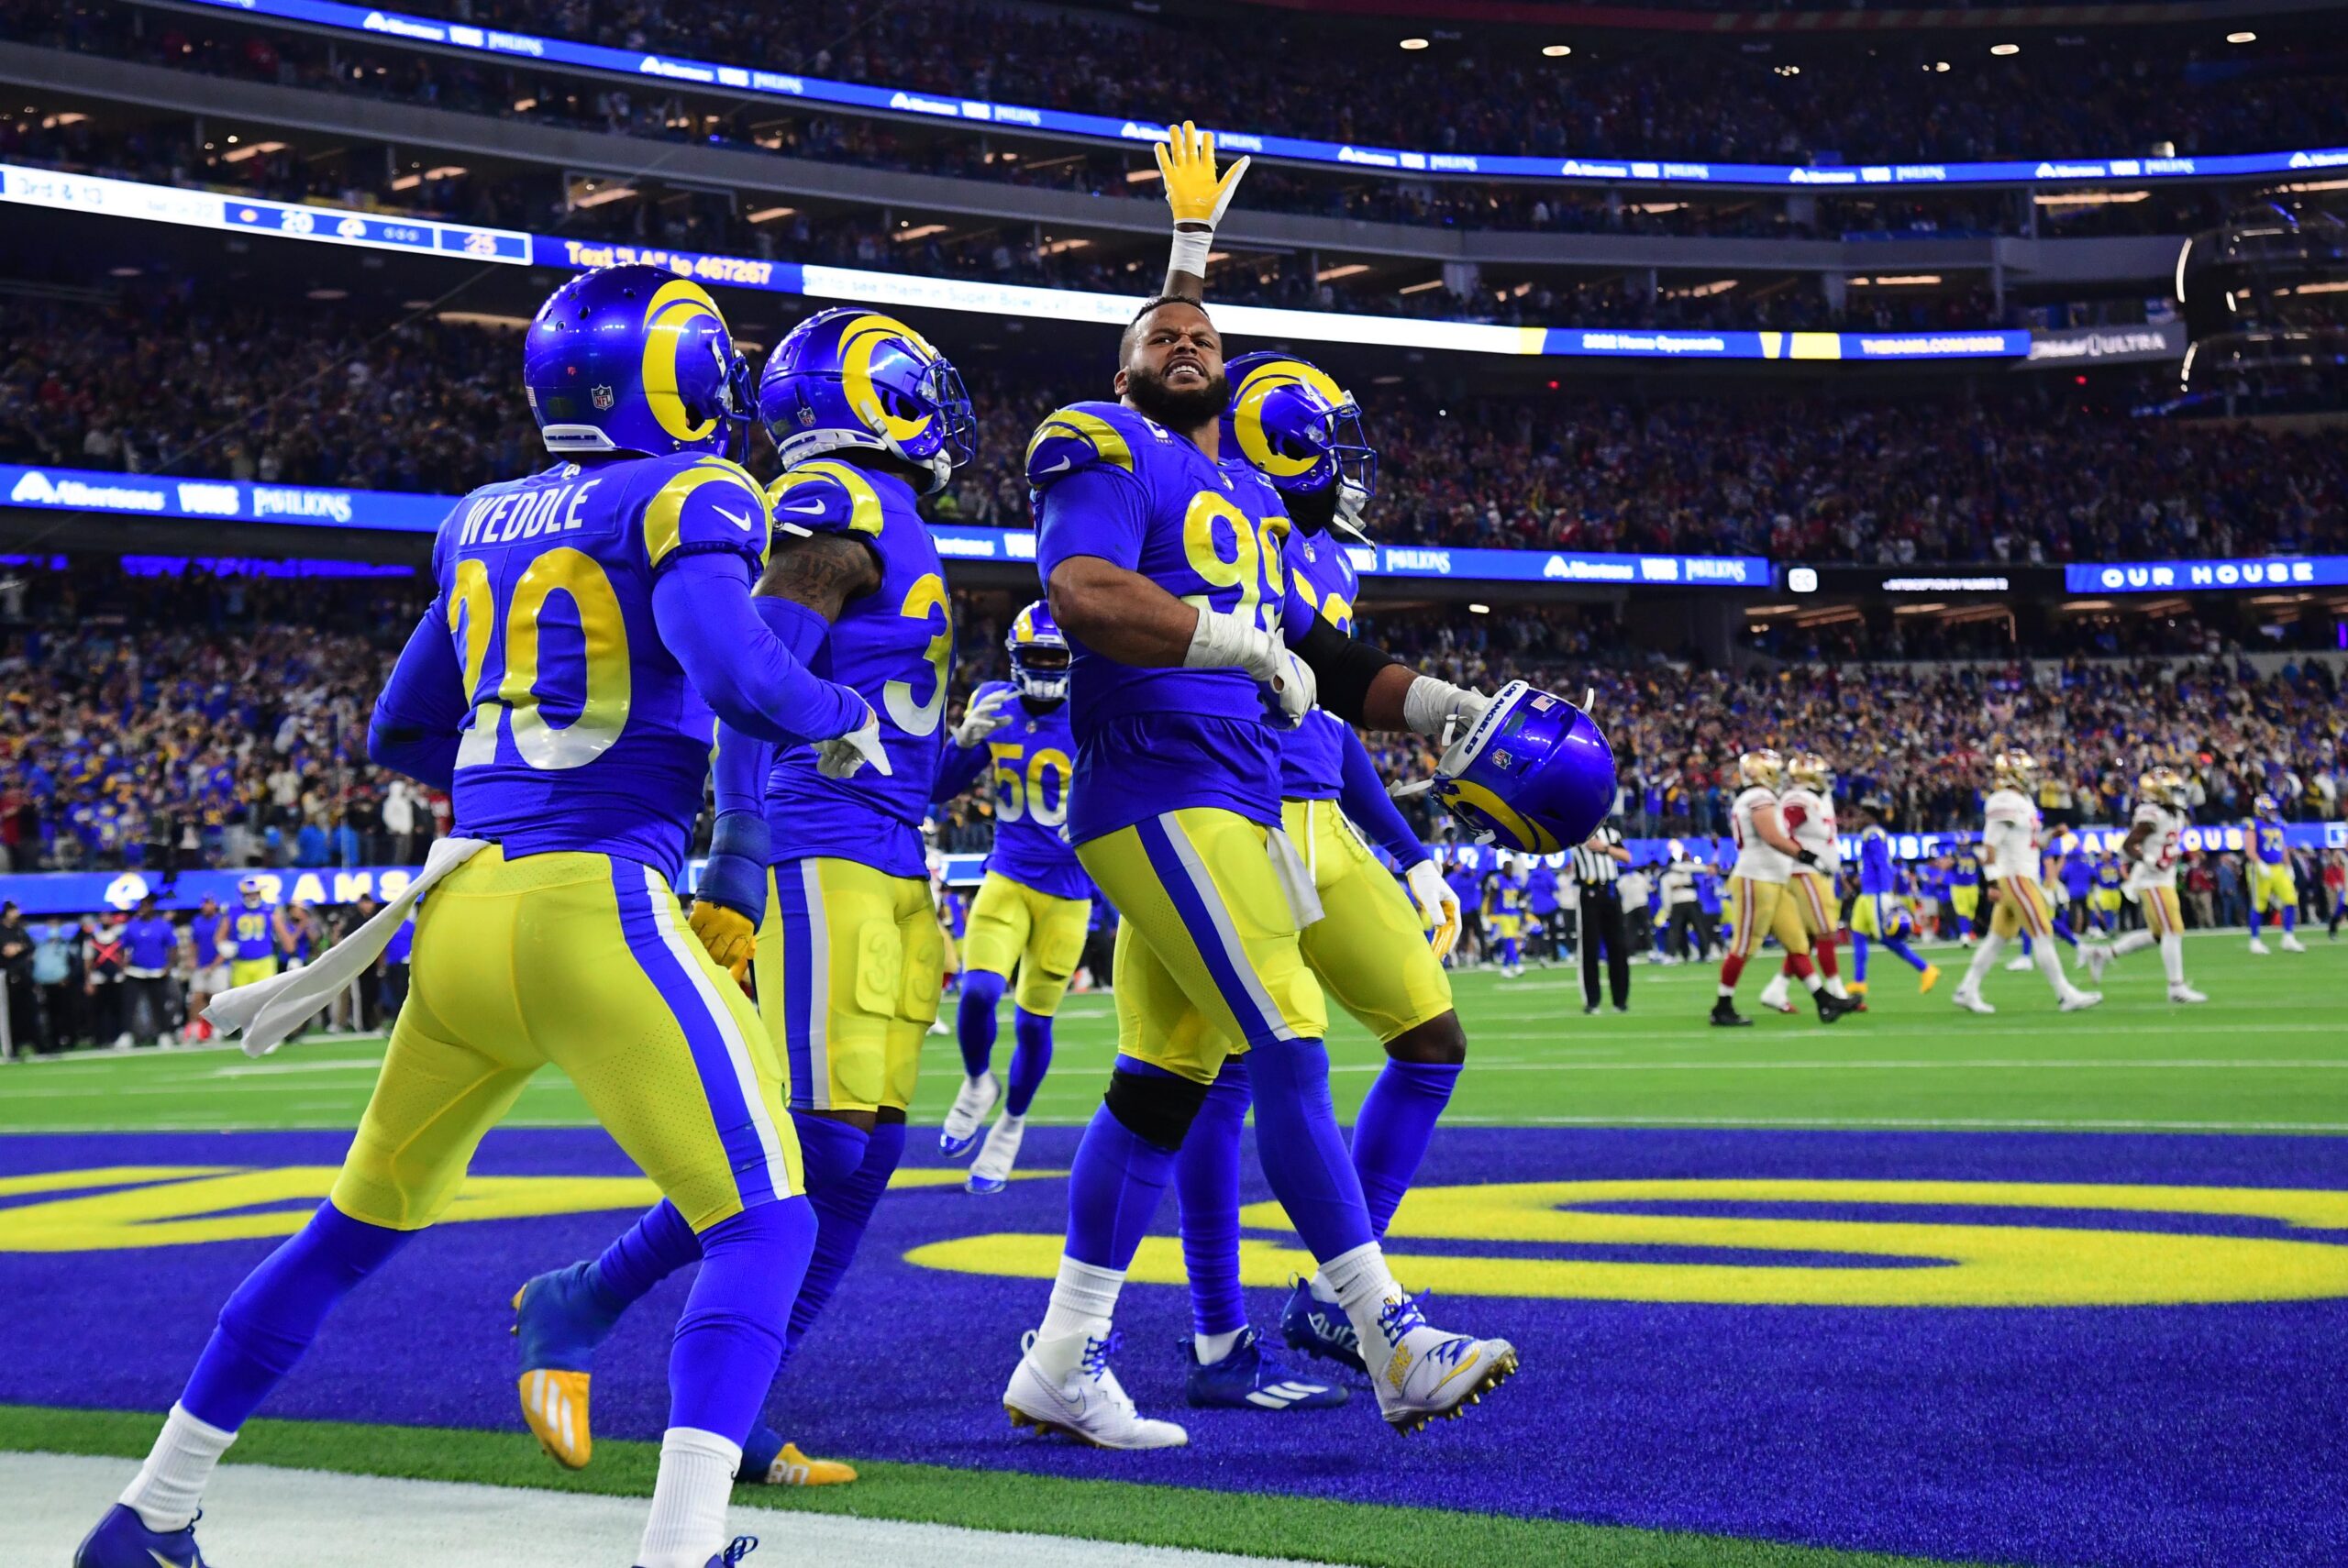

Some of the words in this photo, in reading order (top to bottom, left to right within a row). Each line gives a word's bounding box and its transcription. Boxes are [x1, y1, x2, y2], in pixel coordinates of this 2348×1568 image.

[253, 487, 352, 523] PAVILIONS
[459, 478, 602, 546] WEDDLE
[2101, 566, 2175, 588] OUR
[2191, 561, 2314, 585] HOUSE
[447, 547, 632, 770] 20
[1504, 682, 1521, 697] LOS
[1464, 698, 1505, 755] ANGELES
[988, 742, 1073, 827] 50
[236, 913, 266, 942] 91
